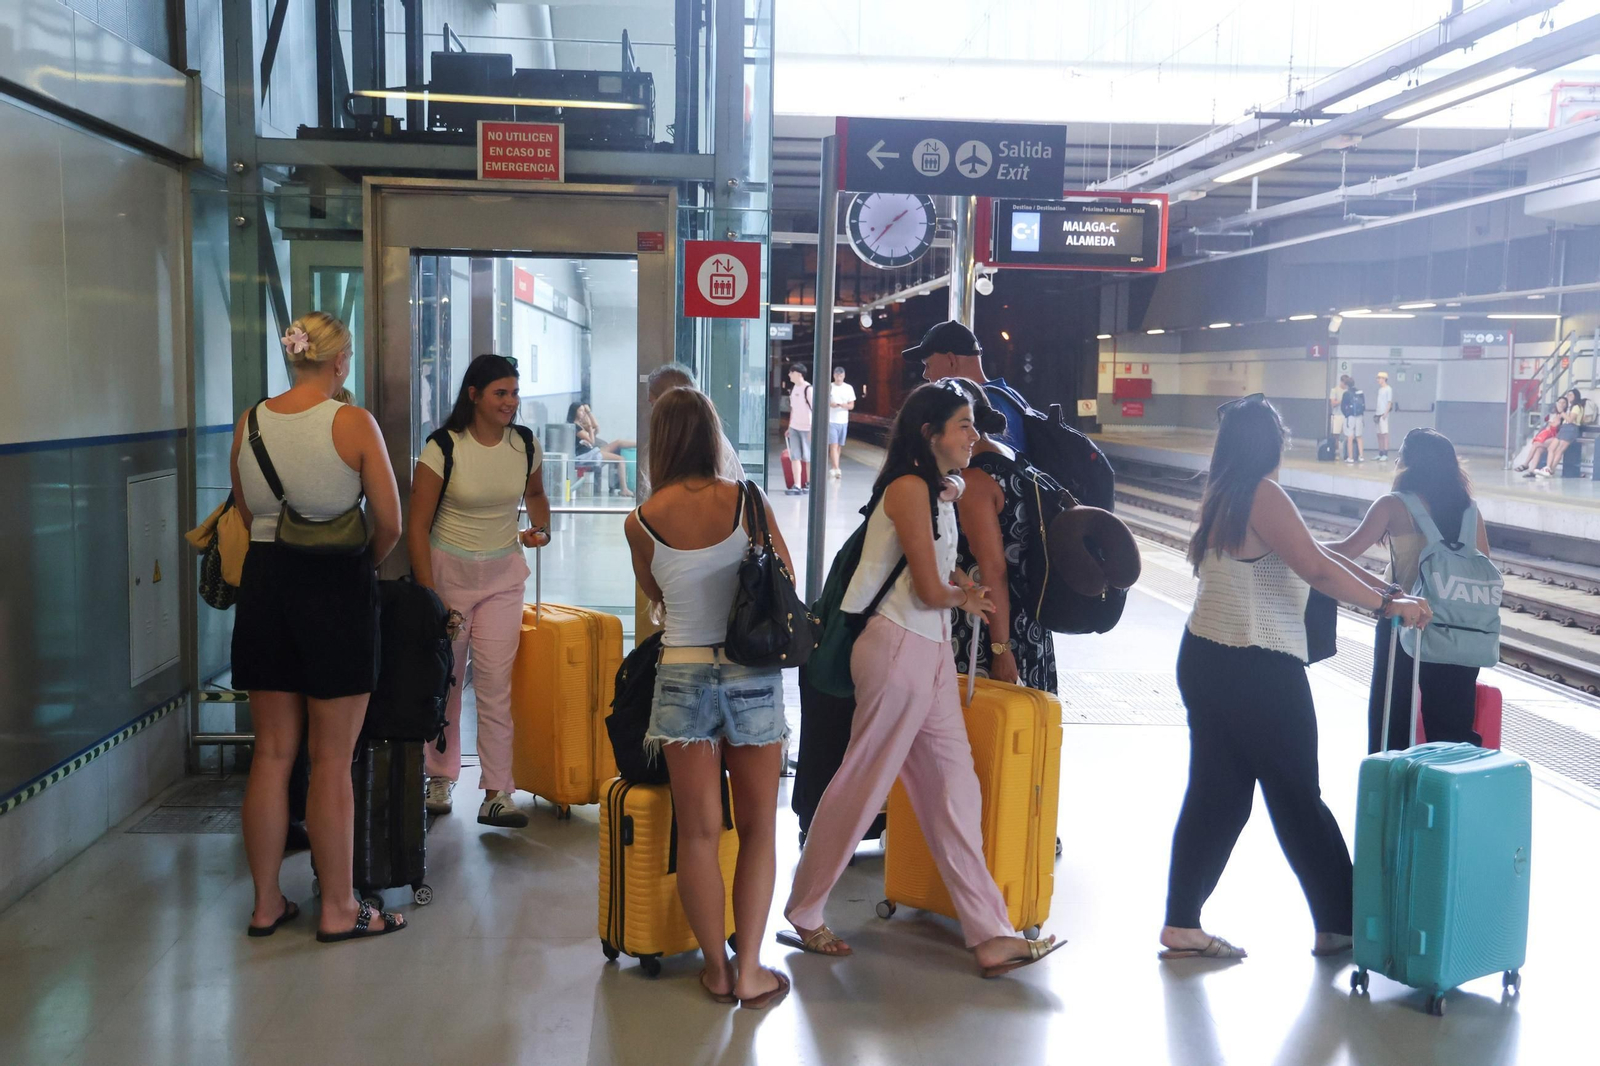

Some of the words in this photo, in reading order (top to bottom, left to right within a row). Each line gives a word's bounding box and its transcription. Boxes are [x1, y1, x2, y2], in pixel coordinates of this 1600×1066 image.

[488, 132, 502, 140] NO
[506, 132, 553, 142] UTILICEN
[490, 147, 502, 156] EN
[506, 148, 534, 157] CASO
[538, 148, 551, 157] DE
[999, 140, 1052, 158] Salida
[485, 162, 555, 172] EMERGENCIA
[996, 164, 1030, 180] Exit
[1012, 222, 1038, 240] C-1
[1063, 221, 1119, 232] MALAGA-C.
[1066, 235, 1116, 246] ALAMEDA
[1312, 345, 1320, 357] 1
[1432, 572, 1504, 605] VANS
